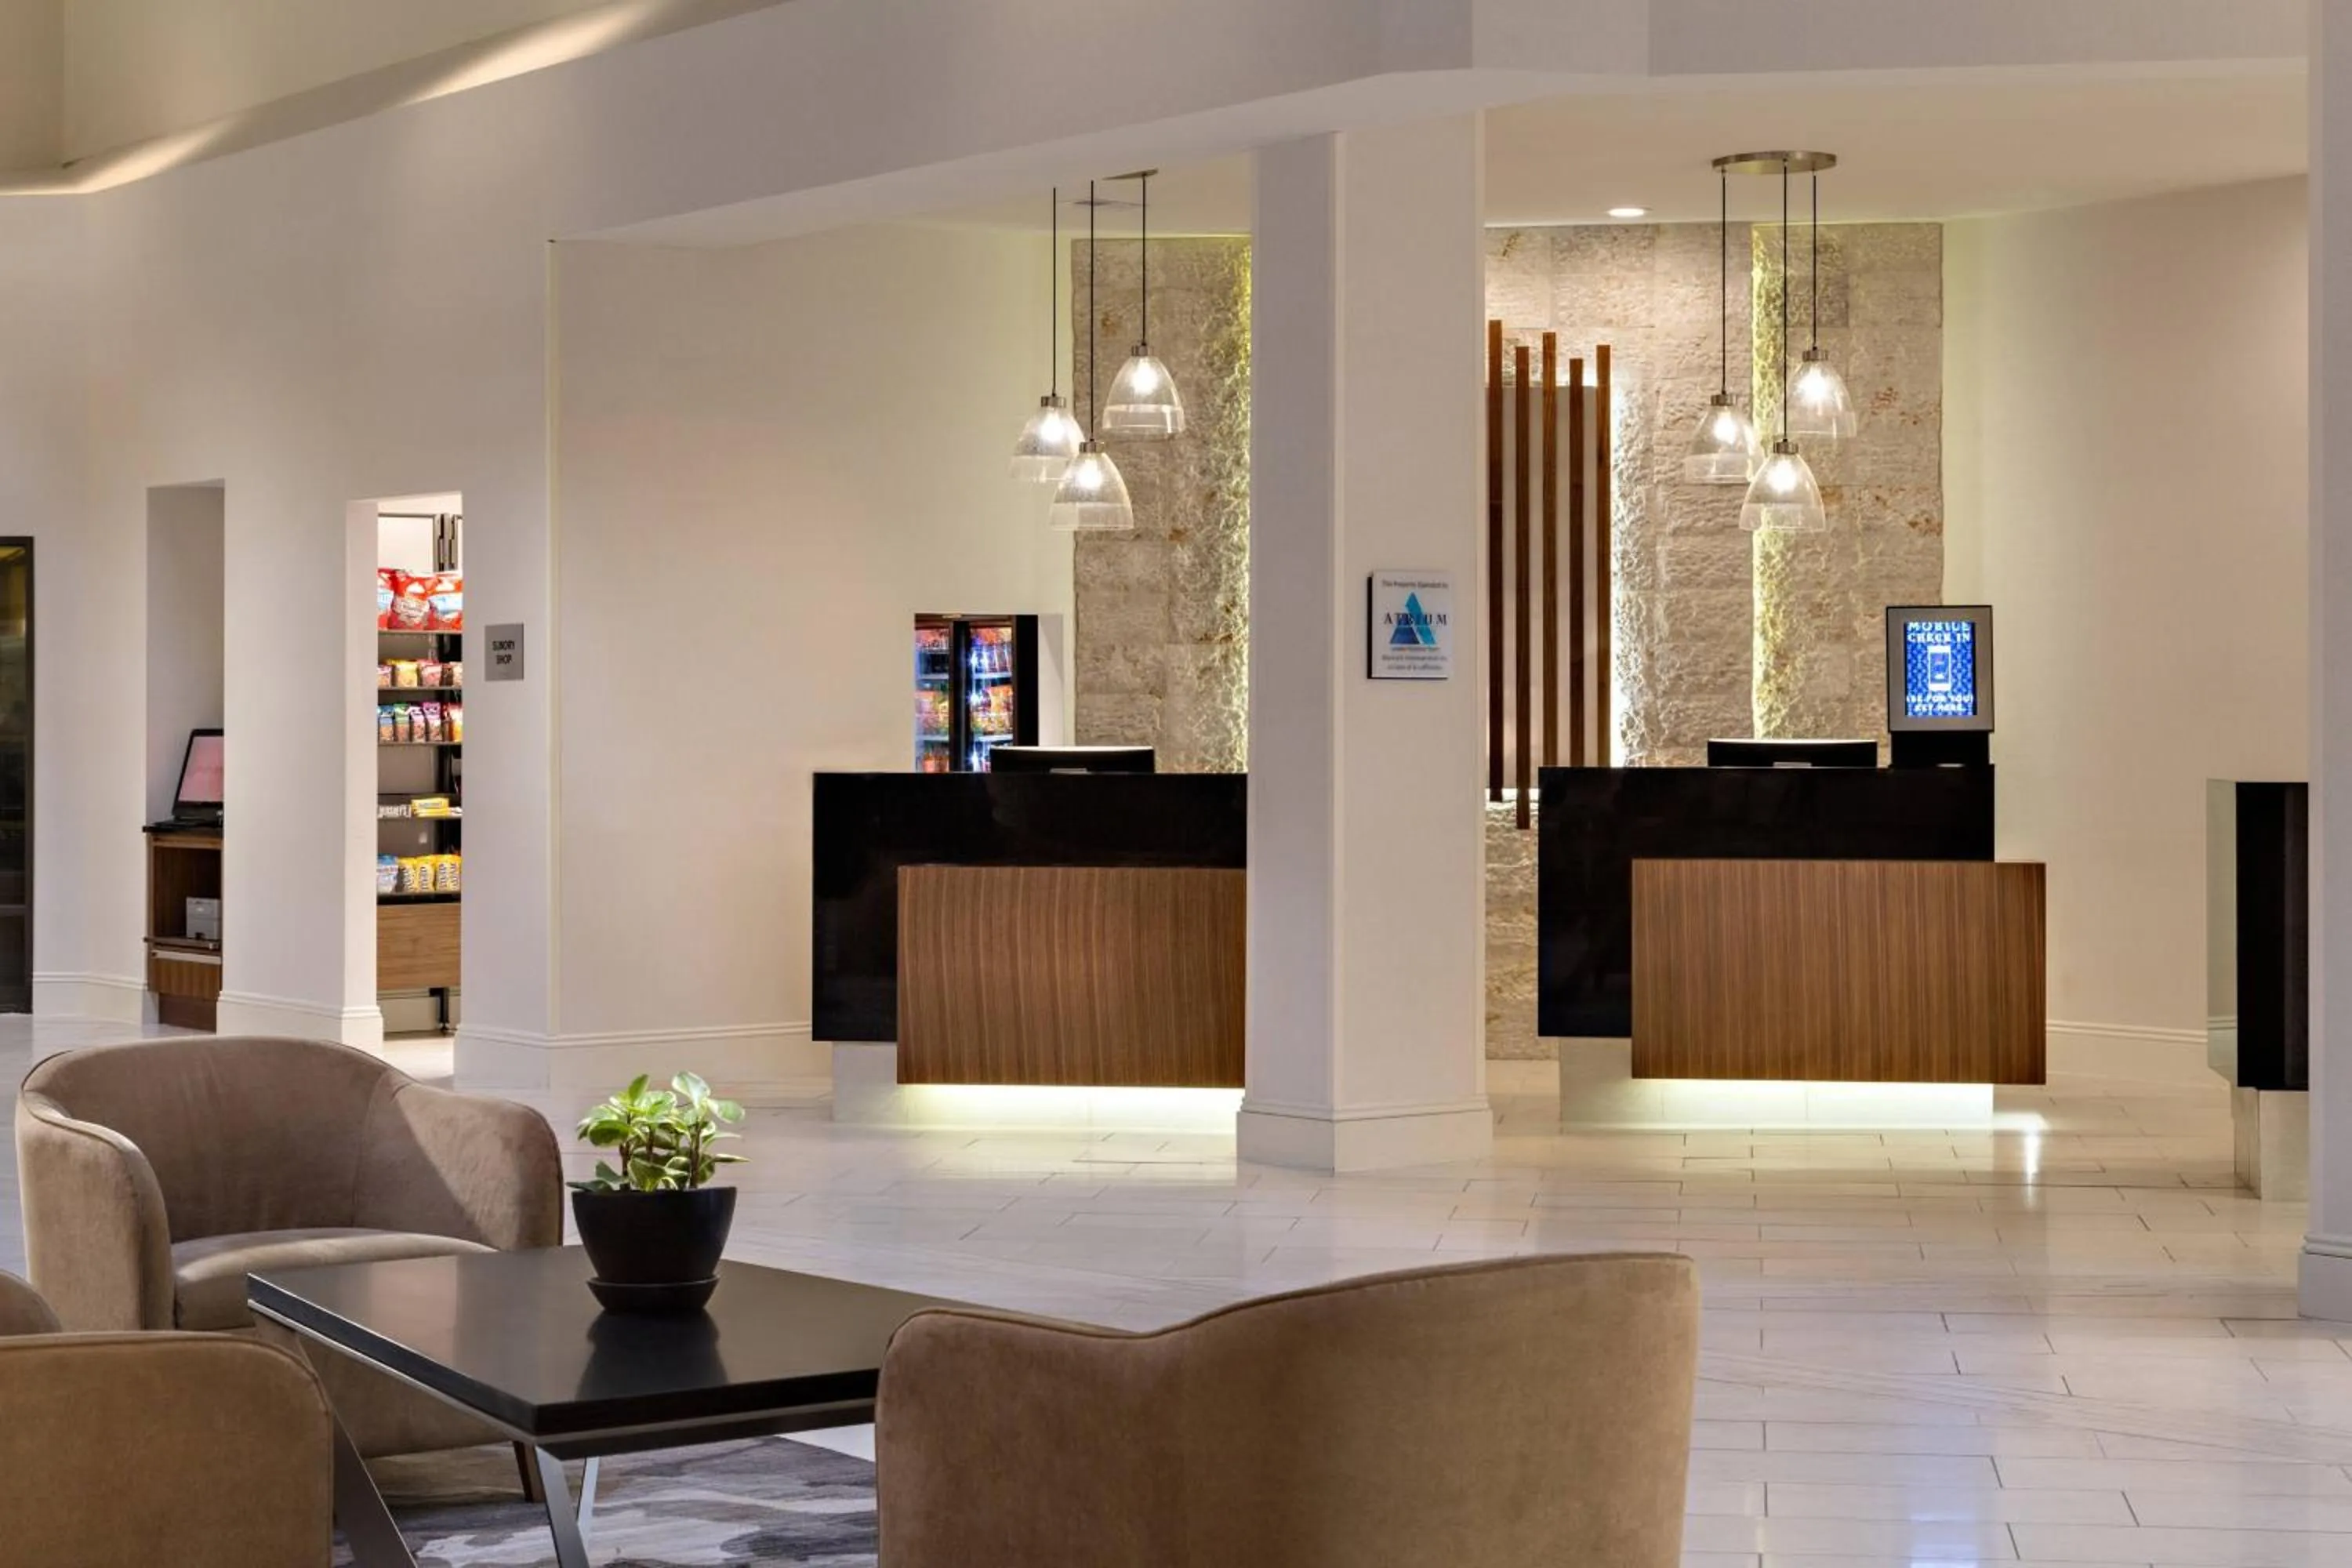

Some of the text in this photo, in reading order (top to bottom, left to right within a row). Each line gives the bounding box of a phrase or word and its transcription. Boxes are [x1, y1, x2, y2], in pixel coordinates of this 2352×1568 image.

[1384, 612, 1447, 626] ATRIUM
[1907, 633, 1971, 642] CHECK IN
